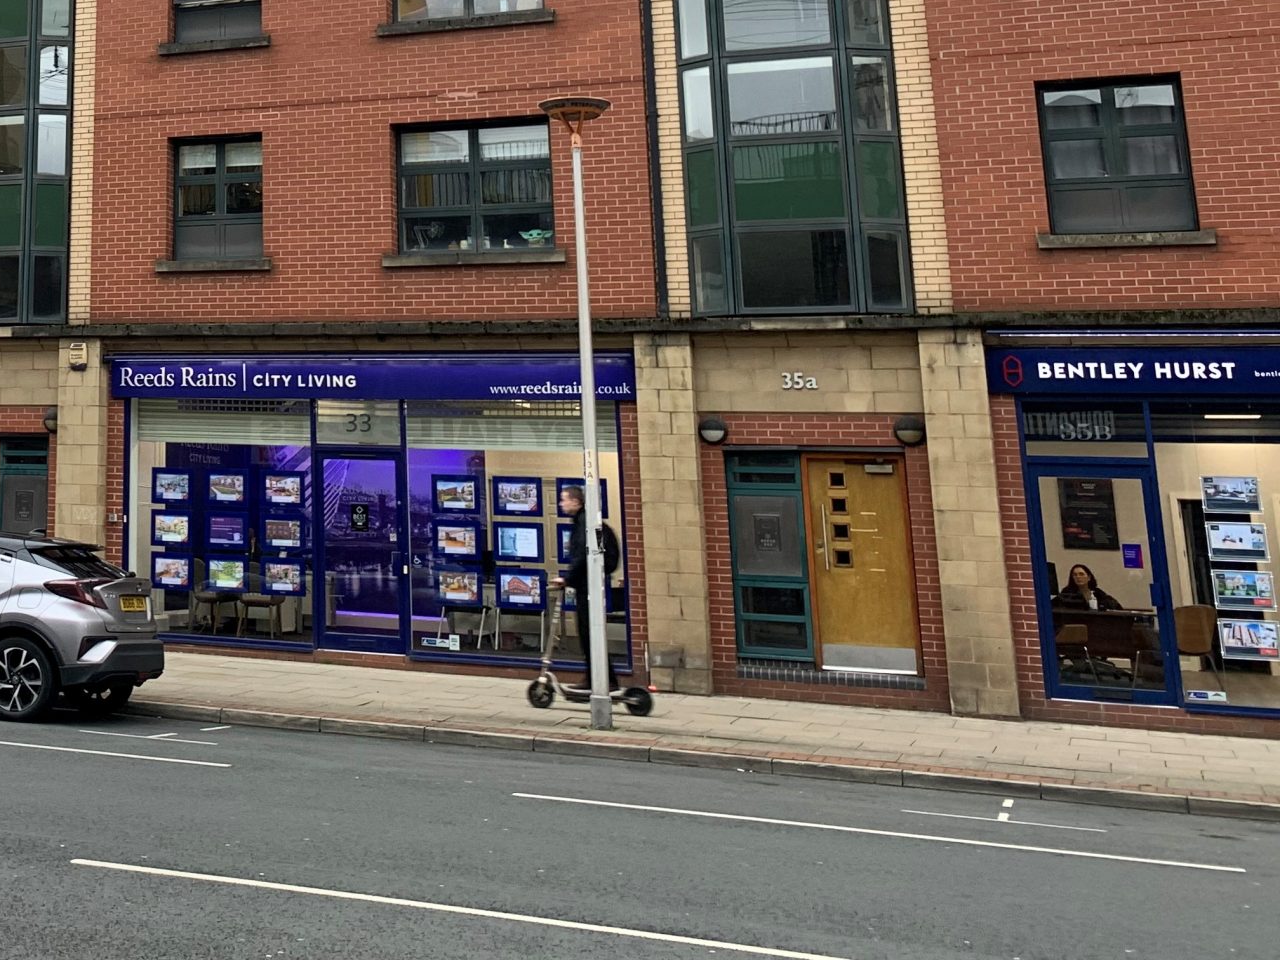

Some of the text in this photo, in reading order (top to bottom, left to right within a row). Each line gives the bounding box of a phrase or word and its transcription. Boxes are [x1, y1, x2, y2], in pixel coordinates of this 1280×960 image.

[120, 367, 357, 387] Reeds Rains CITY LIVING
[1037, 362, 1236, 379] BENTLEY HURST
[490, 381, 631, 395] www.reedsrai.co.uk
[781, 372, 818, 389] 35a
[345, 413, 371, 433] 33
